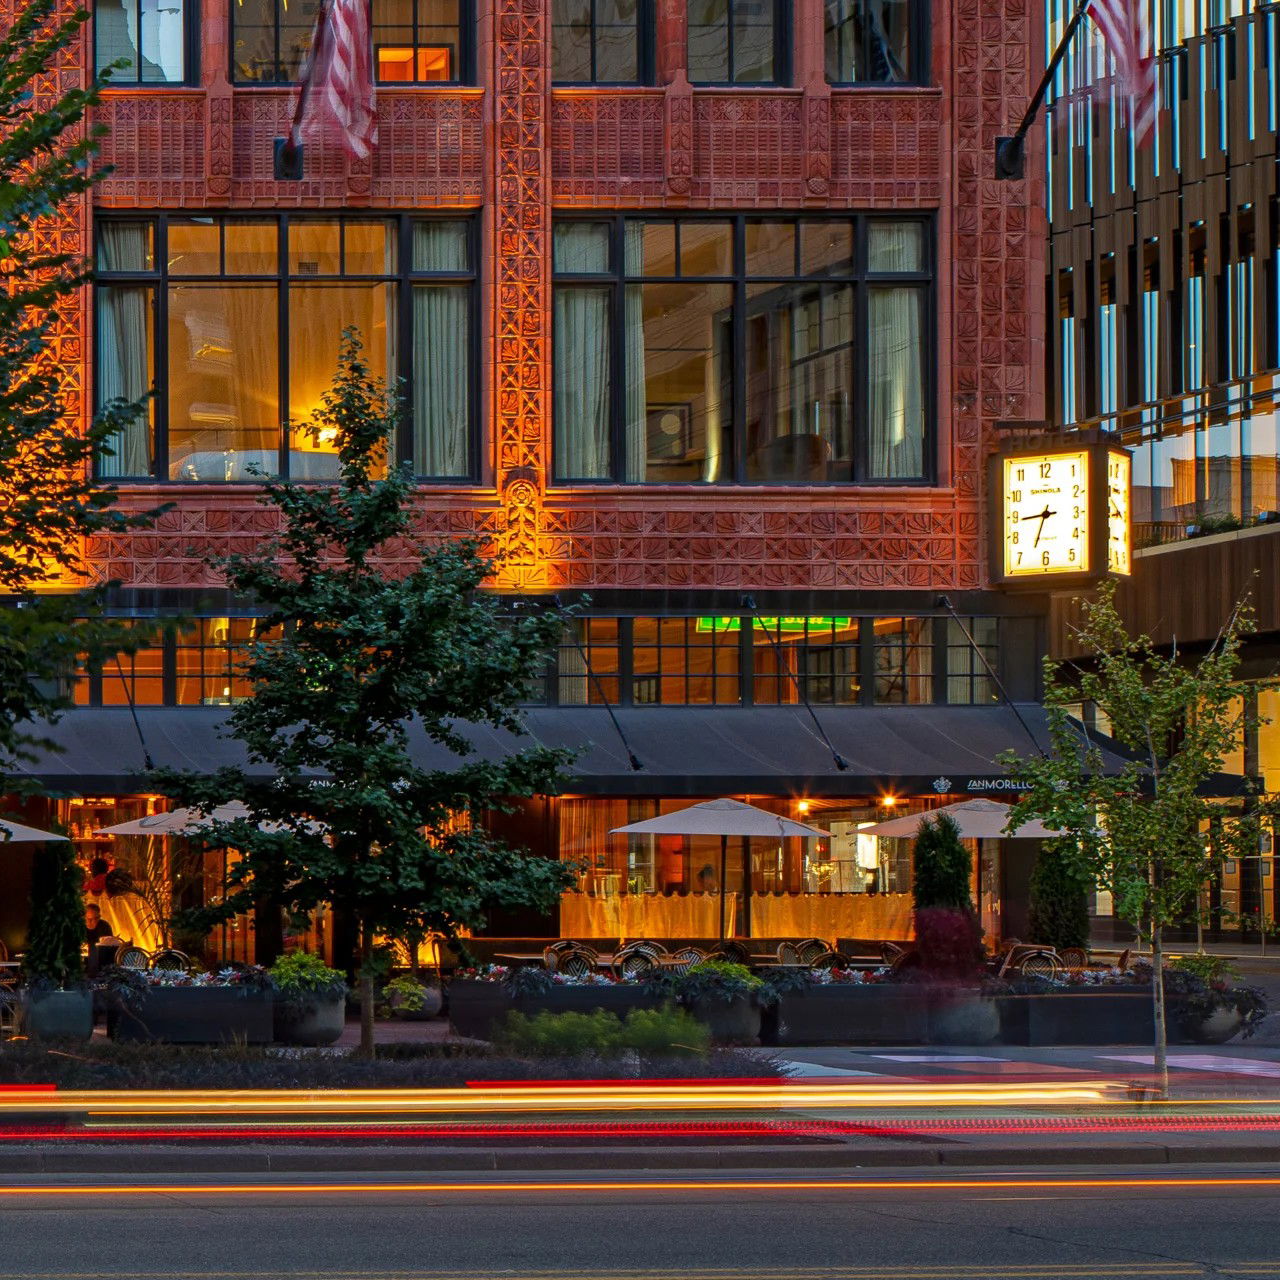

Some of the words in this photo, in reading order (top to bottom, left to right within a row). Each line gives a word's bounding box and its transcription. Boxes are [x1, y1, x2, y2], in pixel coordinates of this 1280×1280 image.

[1017, 469, 1025, 481] 11
[1040, 463, 1051, 478] 12
[1071, 465, 1075, 477] 1
[1012, 490, 1022, 503] 10
[1030, 487, 1061, 495] SHINOLA
[1073, 485, 1079, 498] 2
[1012, 511, 1018, 524] 9
[1073, 506, 1079, 519] 3
[1012, 532, 1019, 544] 8
[1072, 527, 1079, 540] 4
[1017, 552, 1023, 566] 7
[1042, 551, 1050, 566] 6
[1069, 549, 1075, 561] 5
